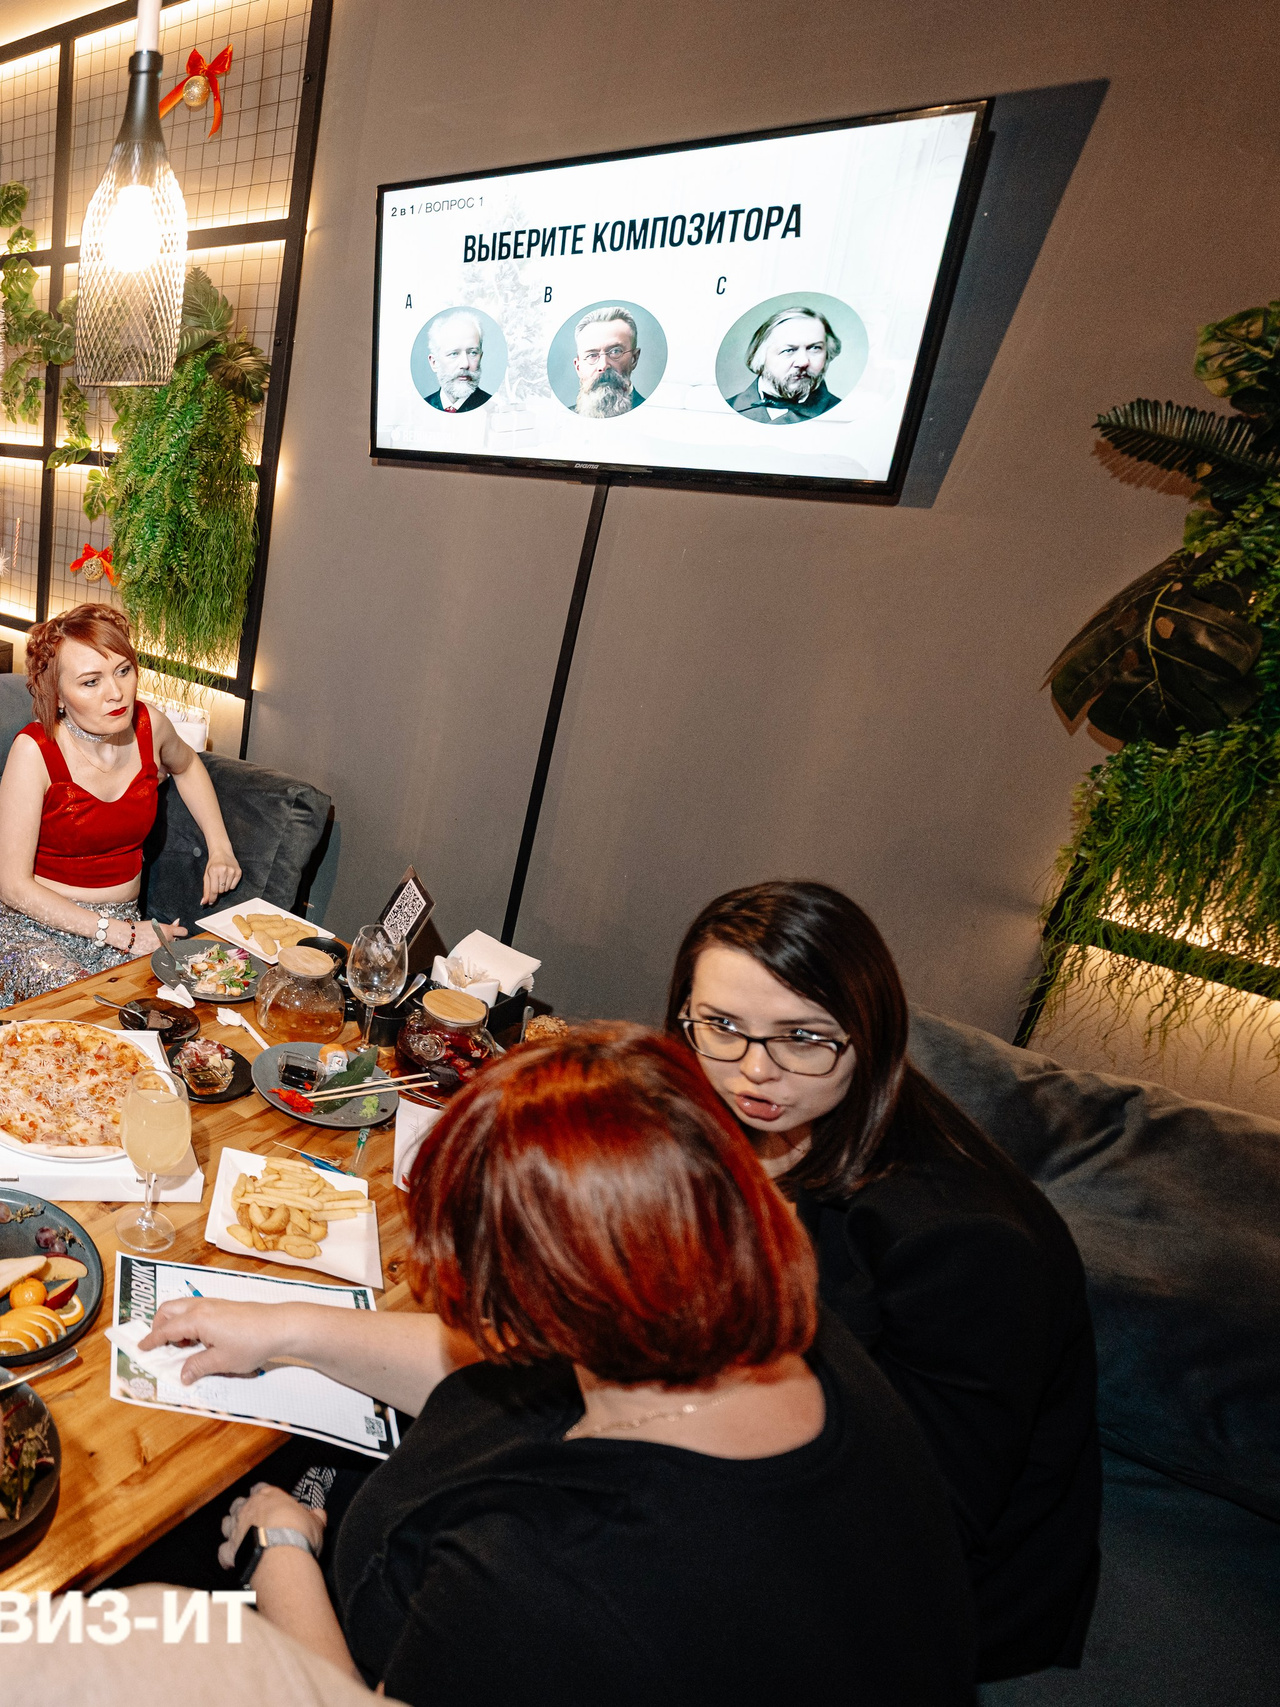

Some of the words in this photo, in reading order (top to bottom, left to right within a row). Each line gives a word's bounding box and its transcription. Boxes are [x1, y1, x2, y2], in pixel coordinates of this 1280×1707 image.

[391, 207, 397, 217] 2
[400, 208, 406, 216] в
[425, 197, 475, 213] ВОПРОС
[479, 196, 484, 206] 1
[463, 224, 586, 263] ВЫБЕРИТЕ
[592, 204, 801, 253] КОМПОЗИТОРА
[131, 1259, 155, 1326] РНОВИК
